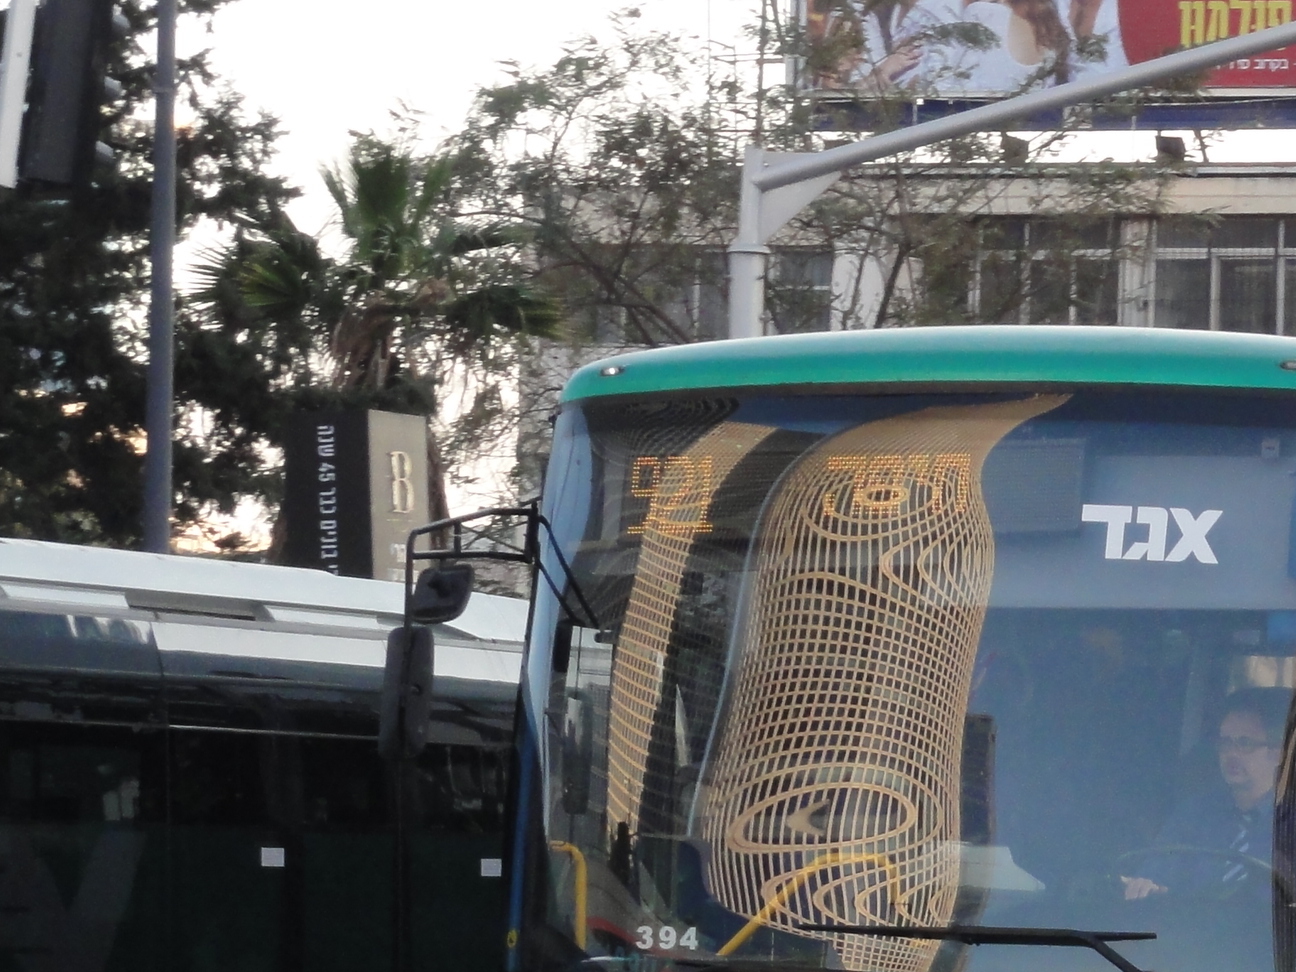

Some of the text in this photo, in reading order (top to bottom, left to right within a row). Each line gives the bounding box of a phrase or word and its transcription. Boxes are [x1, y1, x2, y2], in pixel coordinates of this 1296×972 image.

[316, 425, 335, 457] שנה
[318, 462, 336, 483] 45
[387, 451, 415, 513] B
[319, 487, 337, 514] כבר
[627, 455, 714, 534] 921
[1081, 504, 1223, 564] אגד
[635, 925, 699, 950] 394
